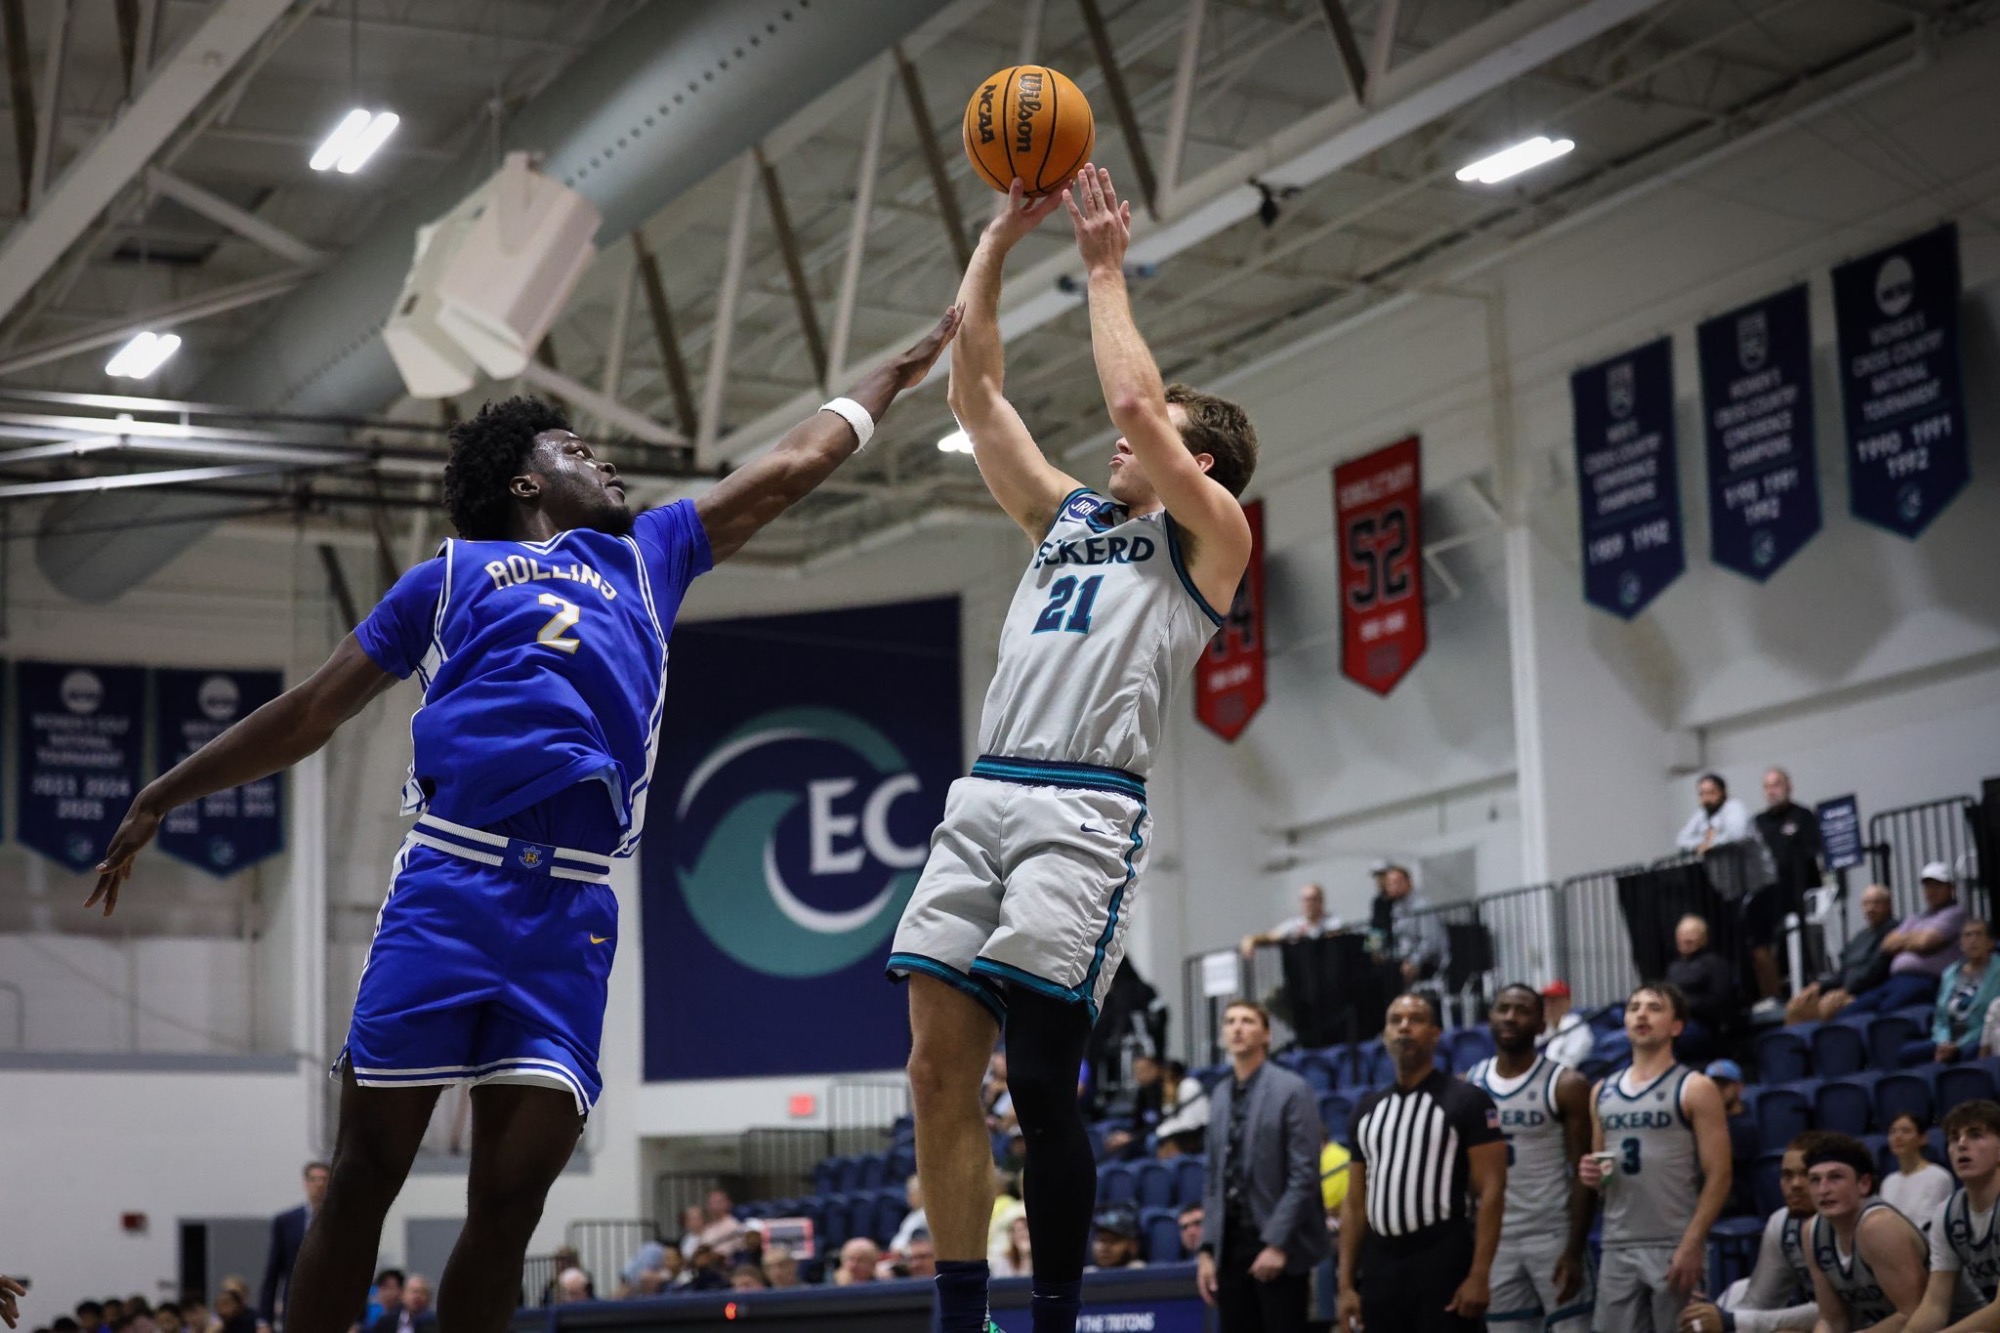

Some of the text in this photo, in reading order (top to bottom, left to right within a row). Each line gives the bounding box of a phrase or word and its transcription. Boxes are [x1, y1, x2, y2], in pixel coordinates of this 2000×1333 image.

[978, 84, 997, 144] NCAA
[1016, 73, 1043, 153] Wilson
[1348, 506, 1411, 608] 52
[537, 593, 580, 654] 2
[1031, 574, 1105, 634] 21
[807, 773, 931, 875] EC
[1603, 1111, 1671, 1129] CKERD
[1621, 1138, 1641, 1175] 3
